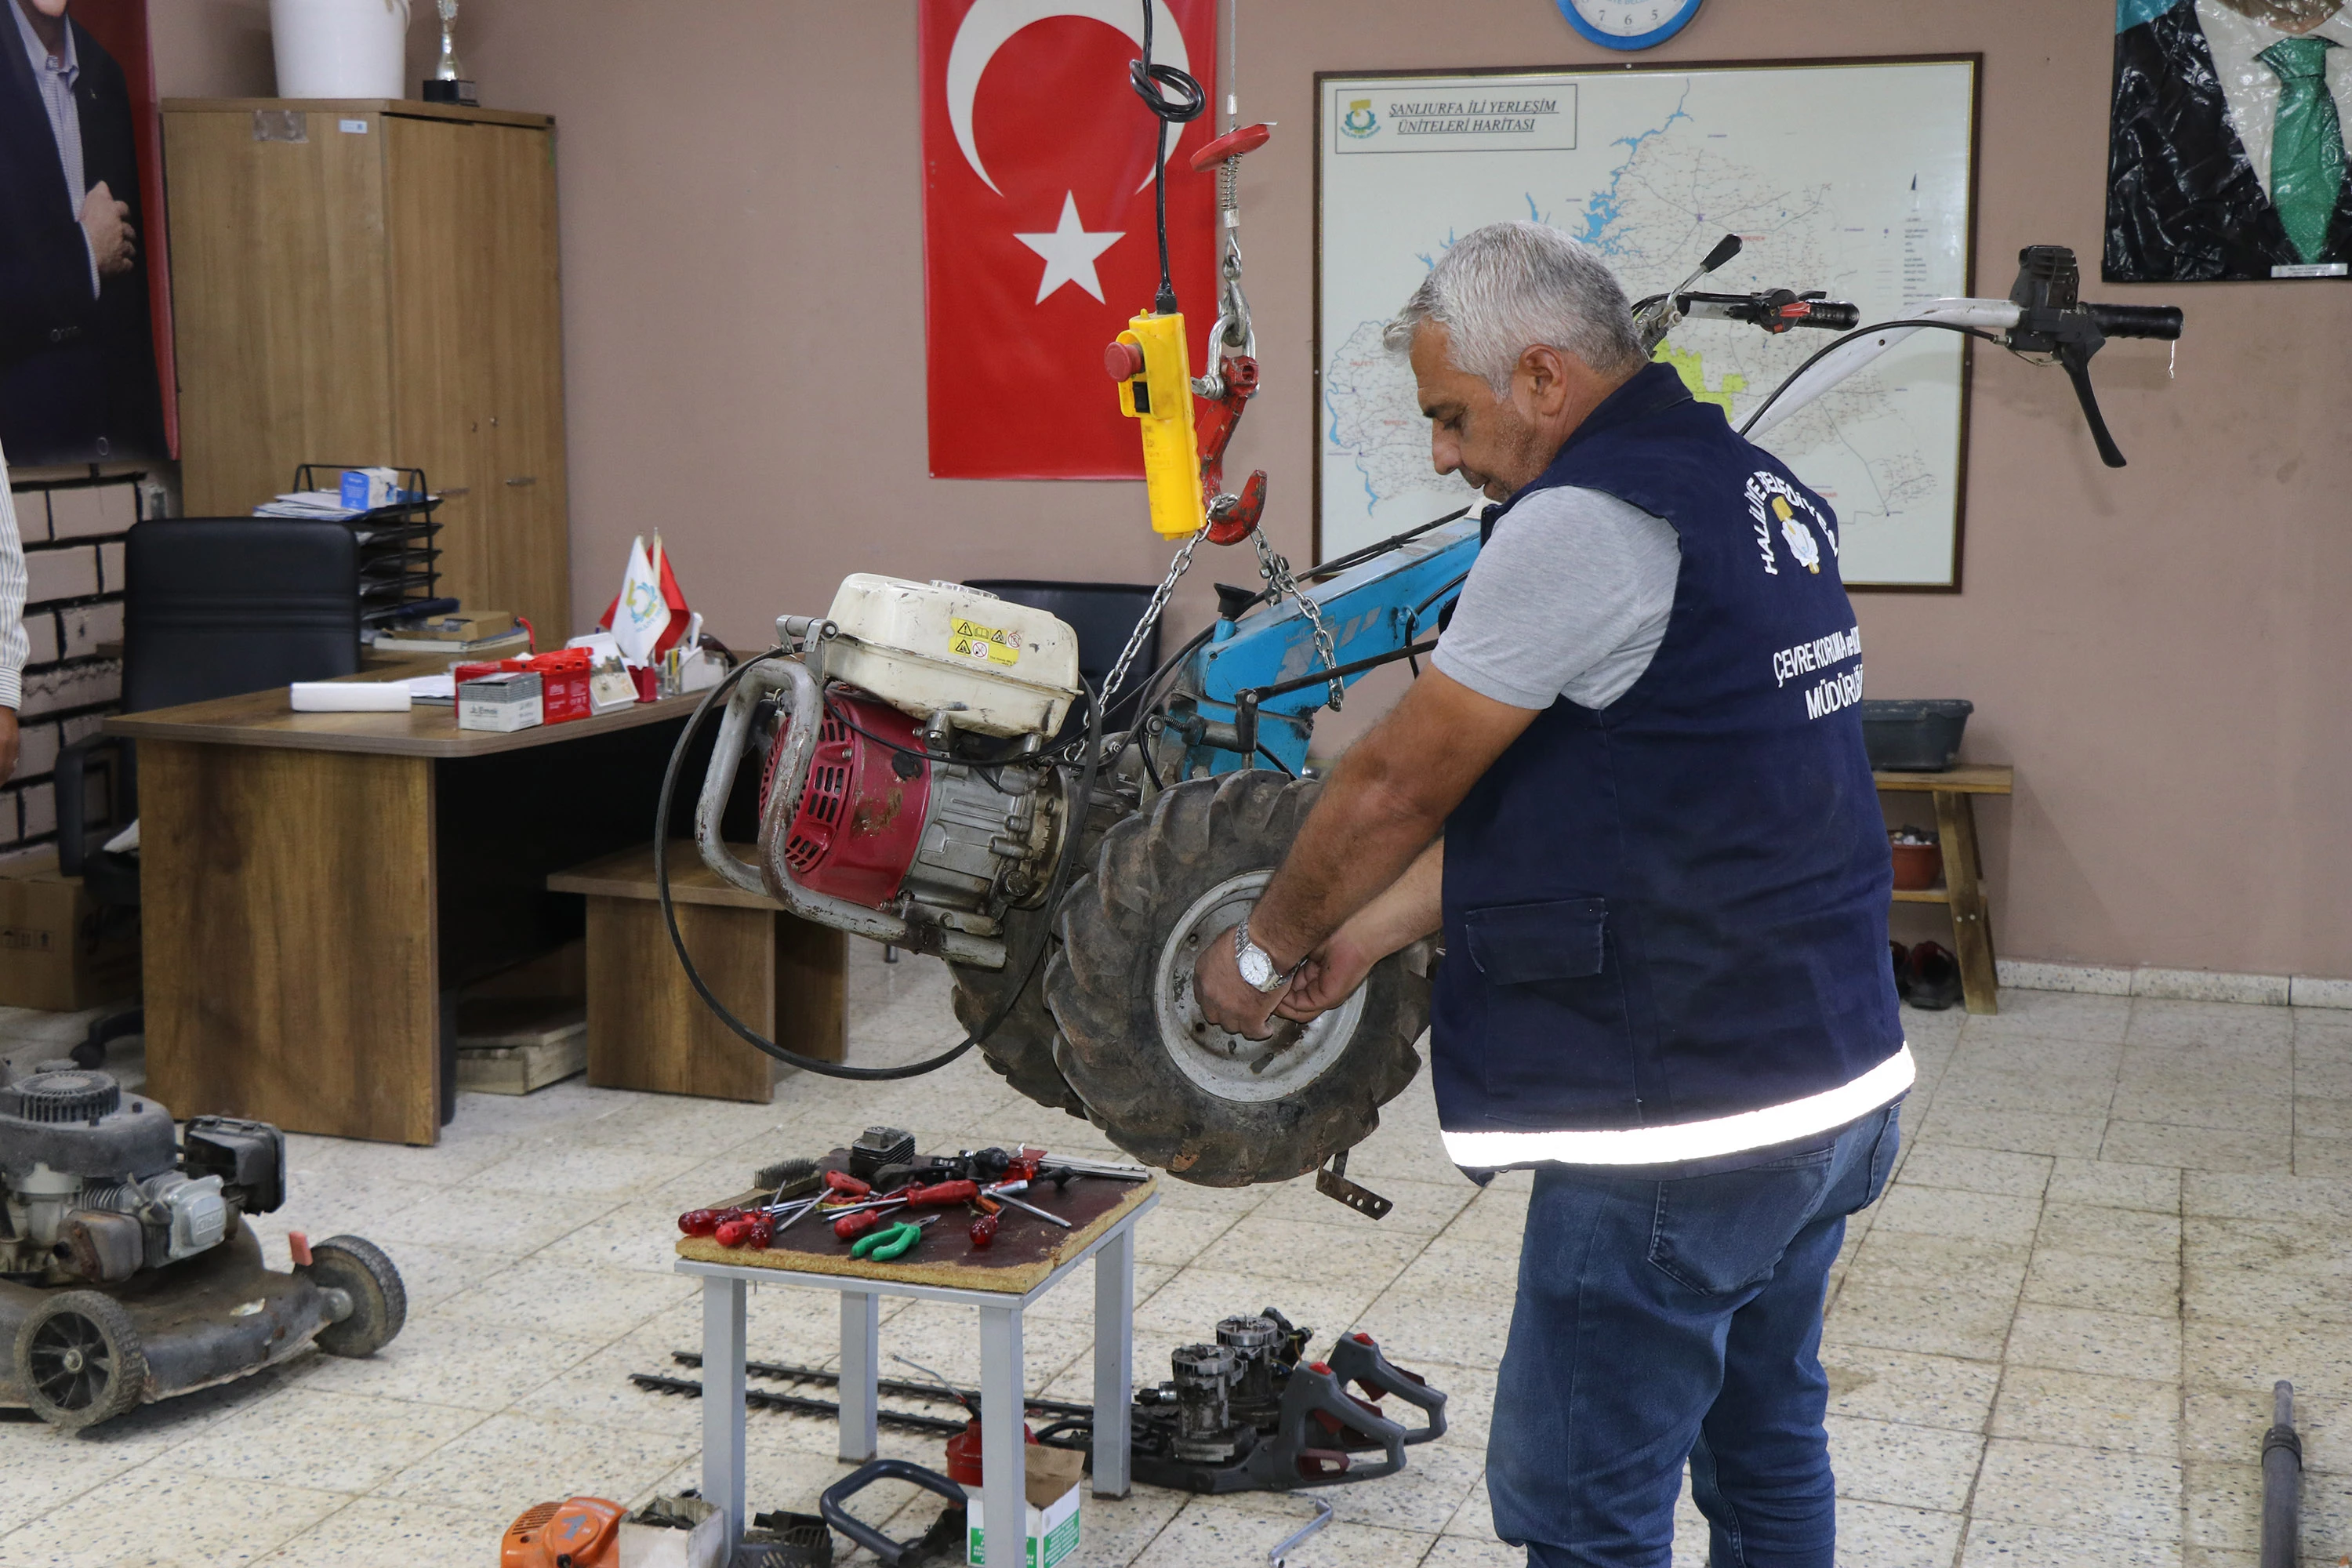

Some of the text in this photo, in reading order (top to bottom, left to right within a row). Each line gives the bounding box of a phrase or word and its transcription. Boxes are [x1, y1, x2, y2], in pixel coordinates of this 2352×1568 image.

[1598, 9, 1606, 22] 7
[1624, 13, 1633, 26] 6
[1650, 9, 1659, 21] 5
[1388, 99, 1557, 118] ŞANLIURFA İLİ YERLEŞİM
[1397, 118, 1471, 133] ÜNİTELERİ
[1472, 117, 1536, 132] HARİTASI
[1773, 642, 1817, 688] ÇEVRE
[1813, 630, 1848, 669] KORUMA
